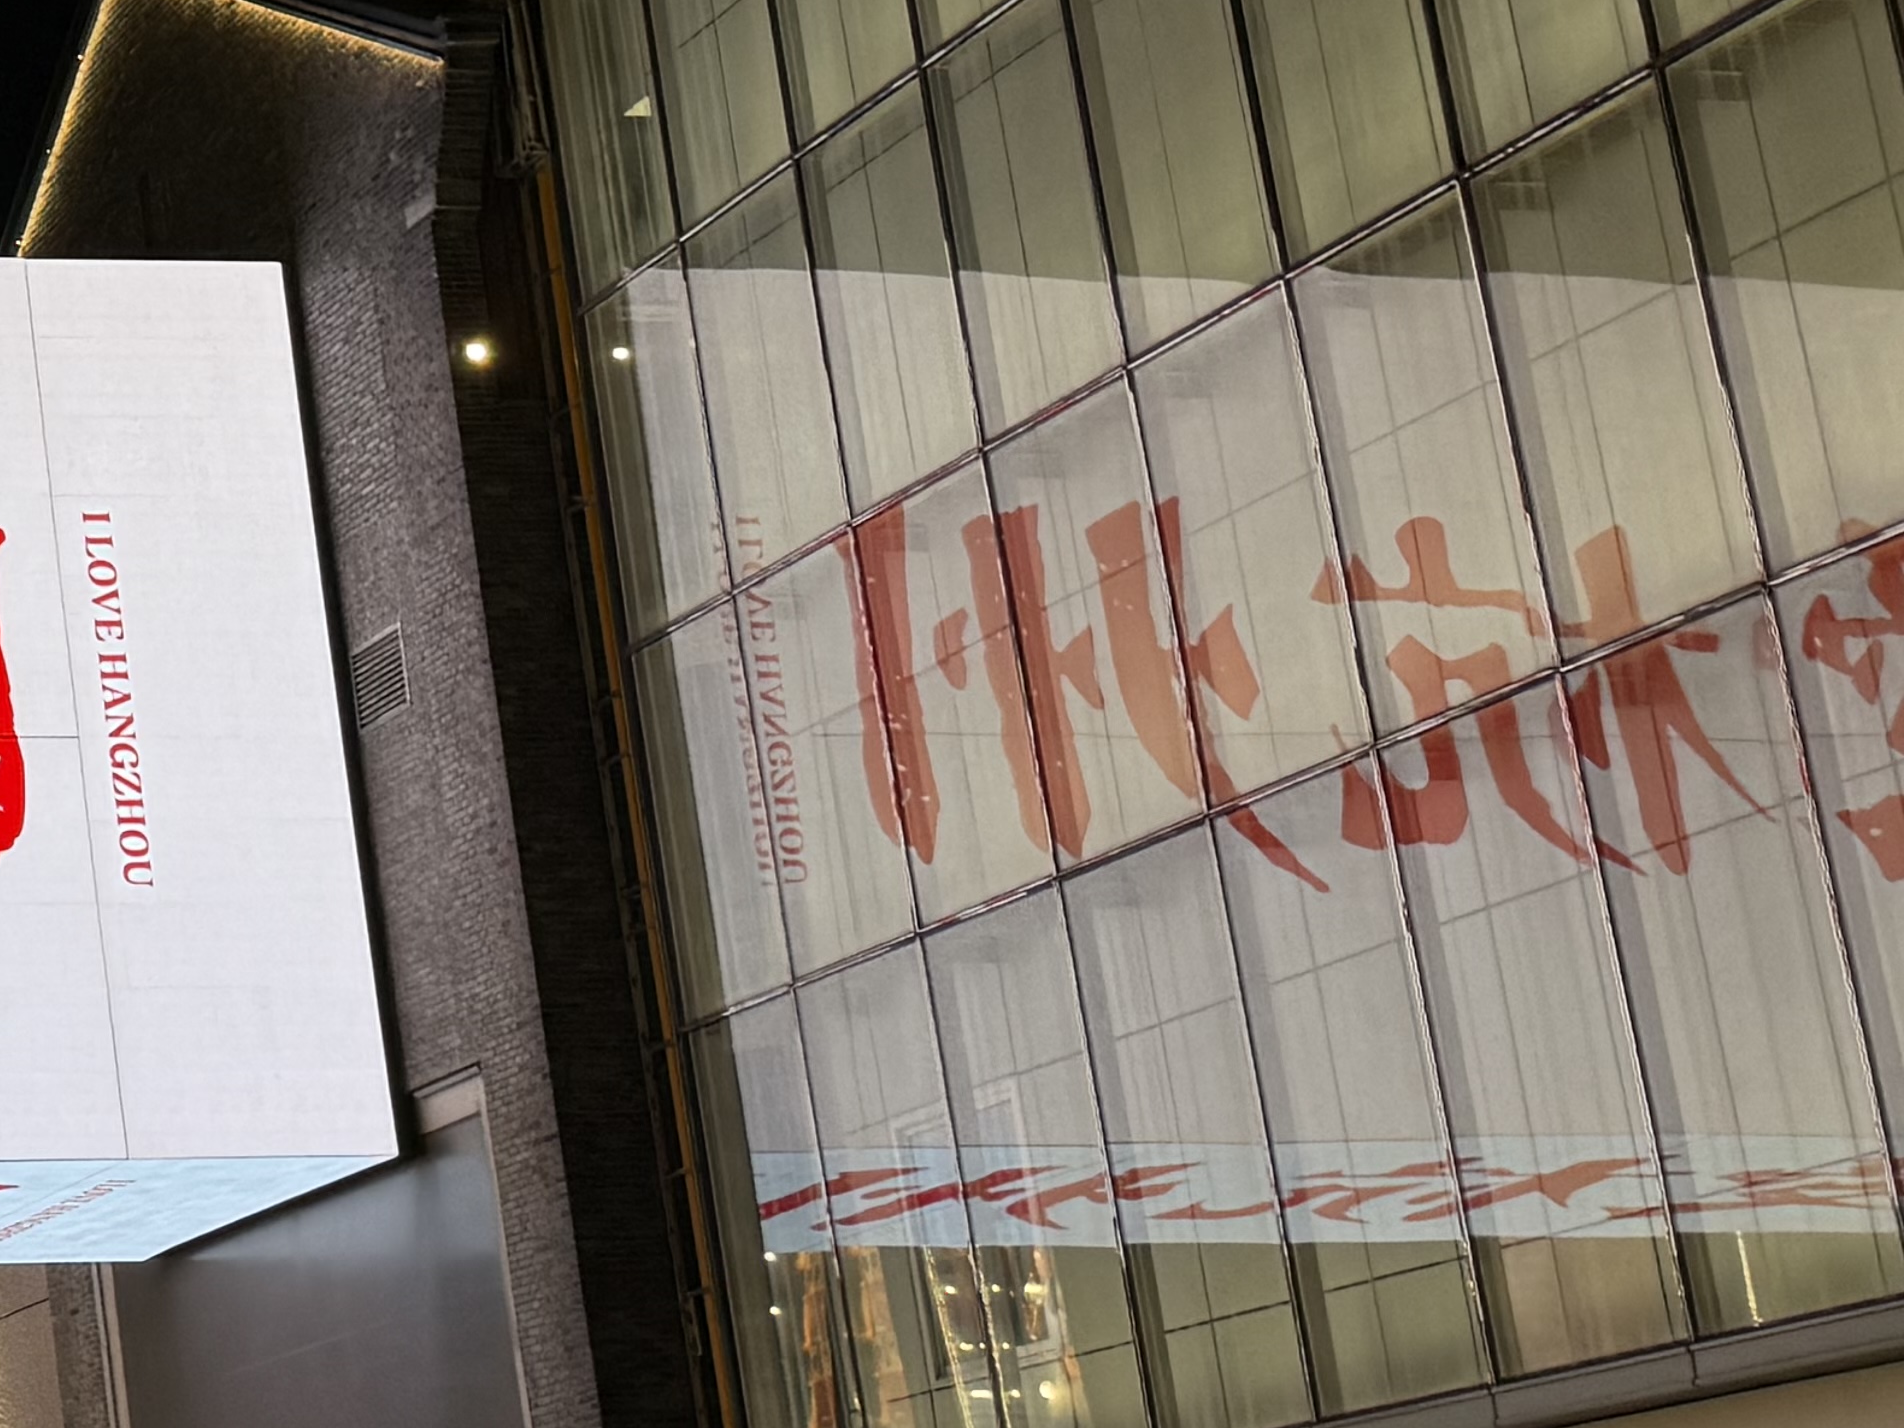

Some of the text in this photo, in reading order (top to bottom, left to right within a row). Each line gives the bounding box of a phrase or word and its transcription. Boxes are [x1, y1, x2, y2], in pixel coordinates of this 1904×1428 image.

[82, 510, 154, 888] I LOVE HANGZHOU
